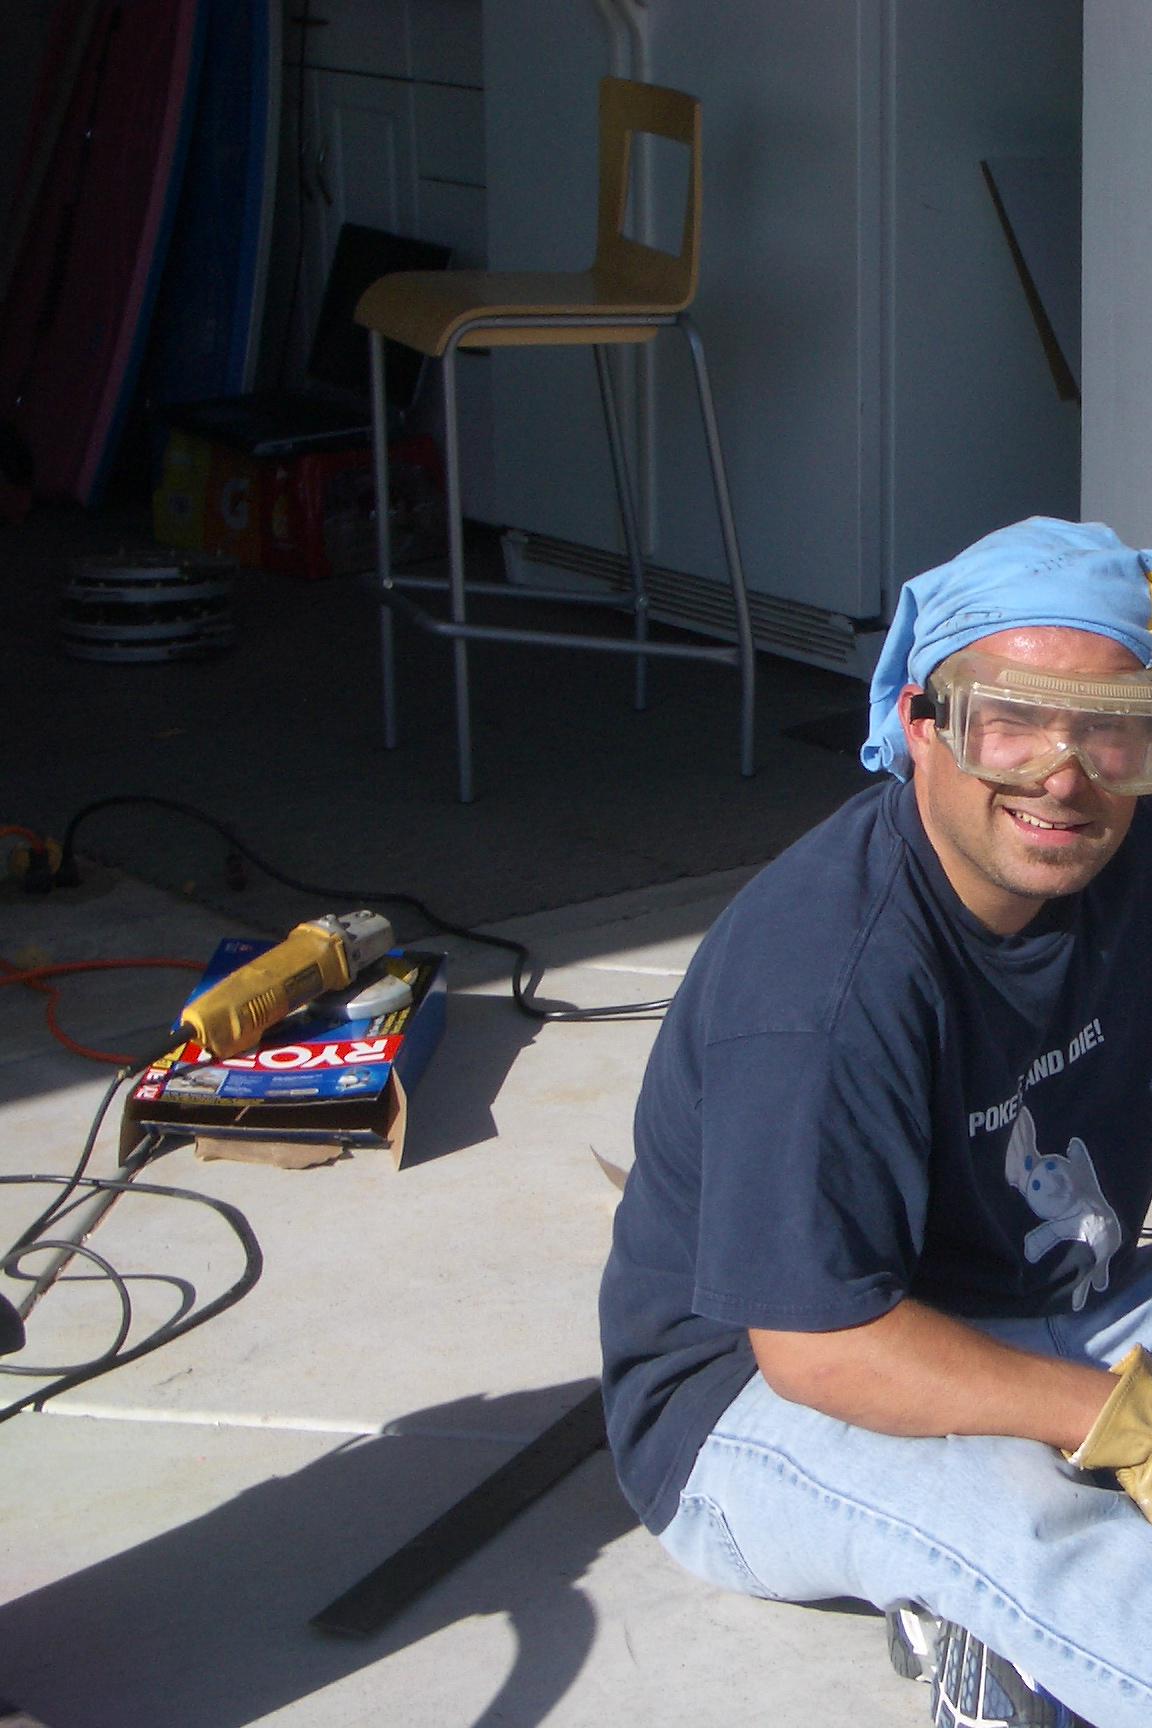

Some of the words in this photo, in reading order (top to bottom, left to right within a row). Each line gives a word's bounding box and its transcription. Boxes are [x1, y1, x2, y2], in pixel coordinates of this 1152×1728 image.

[969, 1095, 1018, 1137] POKE
[1025, 1050, 1065, 1090] AND
[1069, 1018, 1105, 1064] DIE!
